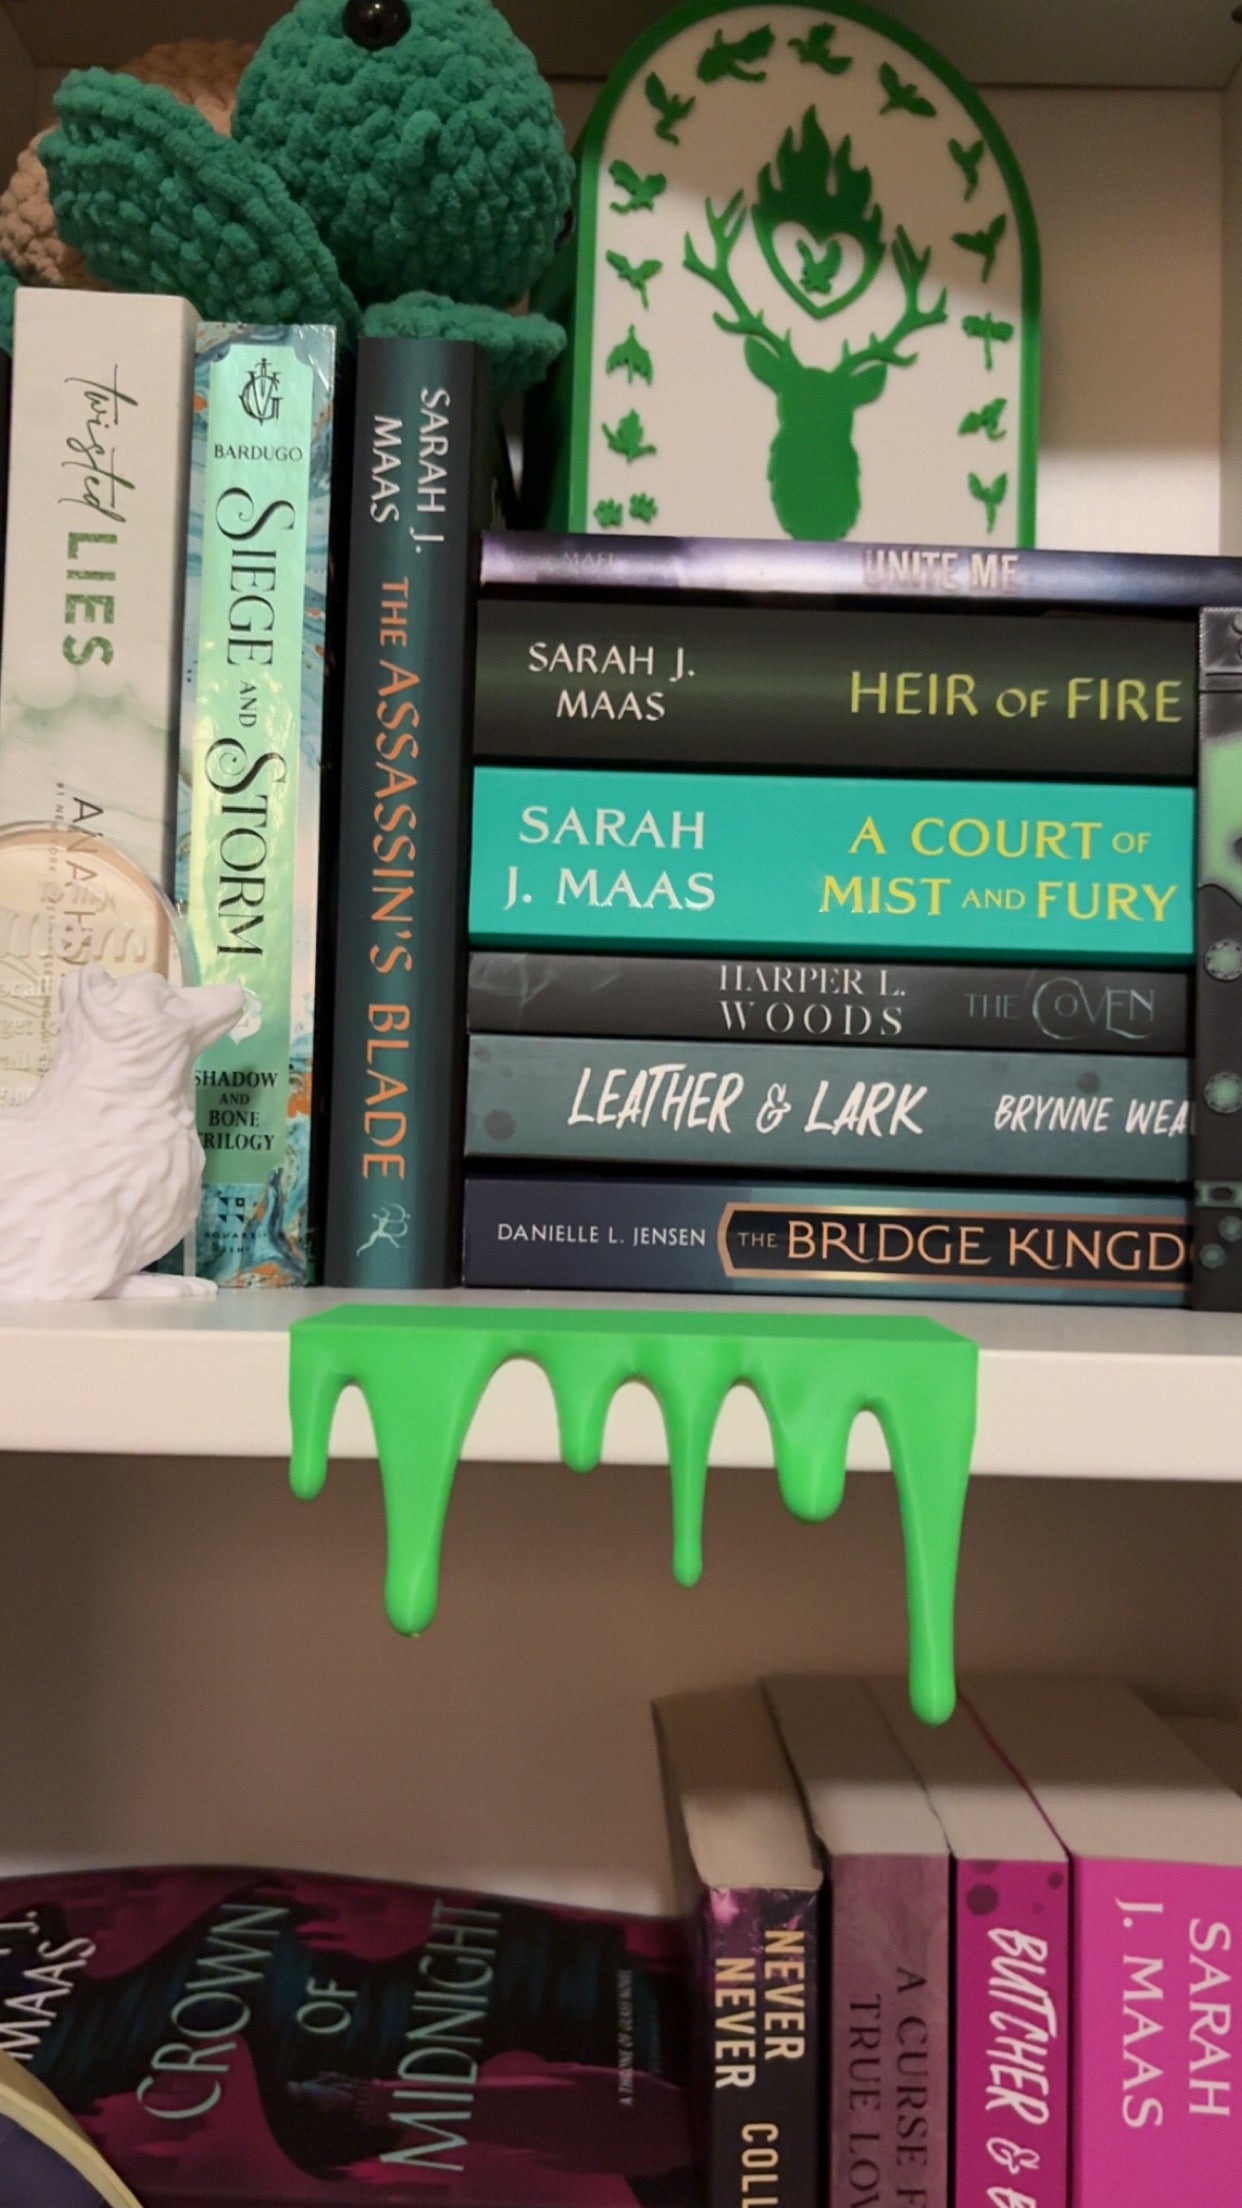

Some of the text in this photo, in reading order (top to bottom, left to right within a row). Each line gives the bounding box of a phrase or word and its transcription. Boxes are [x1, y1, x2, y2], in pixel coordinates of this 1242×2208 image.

[213, 444, 304, 462] BARDUGO
[369, 414, 404, 524] MAAS
[409, 387, 451, 554] SARAH J.
[58, 362, 139, 667] twisted LIES
[863, 548, 1021, 592] UNITE ME
[527, 641, 696, 683] SARAH J.
[555, 689, 667, 722] MAAS
[849, 670, 979, 717] HEIR
[1067, 676, 1183, 723] FIRE
[204, 486, 296, 958] SIEGE AND STORM
[518, 805, 706, 850] SARAH
[848, 815, 1152, 861] A COURT OF
[361, 575, 422, 1181] THE ASSASSIN'S BLADE
[503, 864, 716, 912] J. MAAS
[817, 874, 1178, 922] MIST AND FURY
[719, 963, 907, 998] HARPER L.
[719, 1000, 904, 1036] WOODS
[963, 976, 1155, 1041] THE COVEN
[208, 1109, 260, 1128] BONE
[219, 1093, 250, 1105] AND
[567, 1063, 928, 1138] LEATHER & LARK
[993, 1093, 1114, 1132] BRYNNE
[497, 1222, 706, 1247] DANIELLE L. JENSEN
[736, 1231, 778, 1249] THE
[787, 1219, 992, 1266] BRIDGE
[0, 1937, 97, 2060] MAAS
[764, 1929, 805, 2061] NEVER
[896, 1966, 928, 1994] A
[136, 1899, 501, 2172] CROWN OF MIDNIGHT
[714, 1957, 756, 2090] NEVER
[985, 1927, 1057, 2126] BUTCHER
[1115, 1897, 1165, 2129] J. MAAS
[1189, 1917, 1233, 2117] SARAH
[849, 1993, 881, 2112] TRUE
[896, 2015, 928, 2167] CURSE
[986, 2136, 1041, 2176] &
